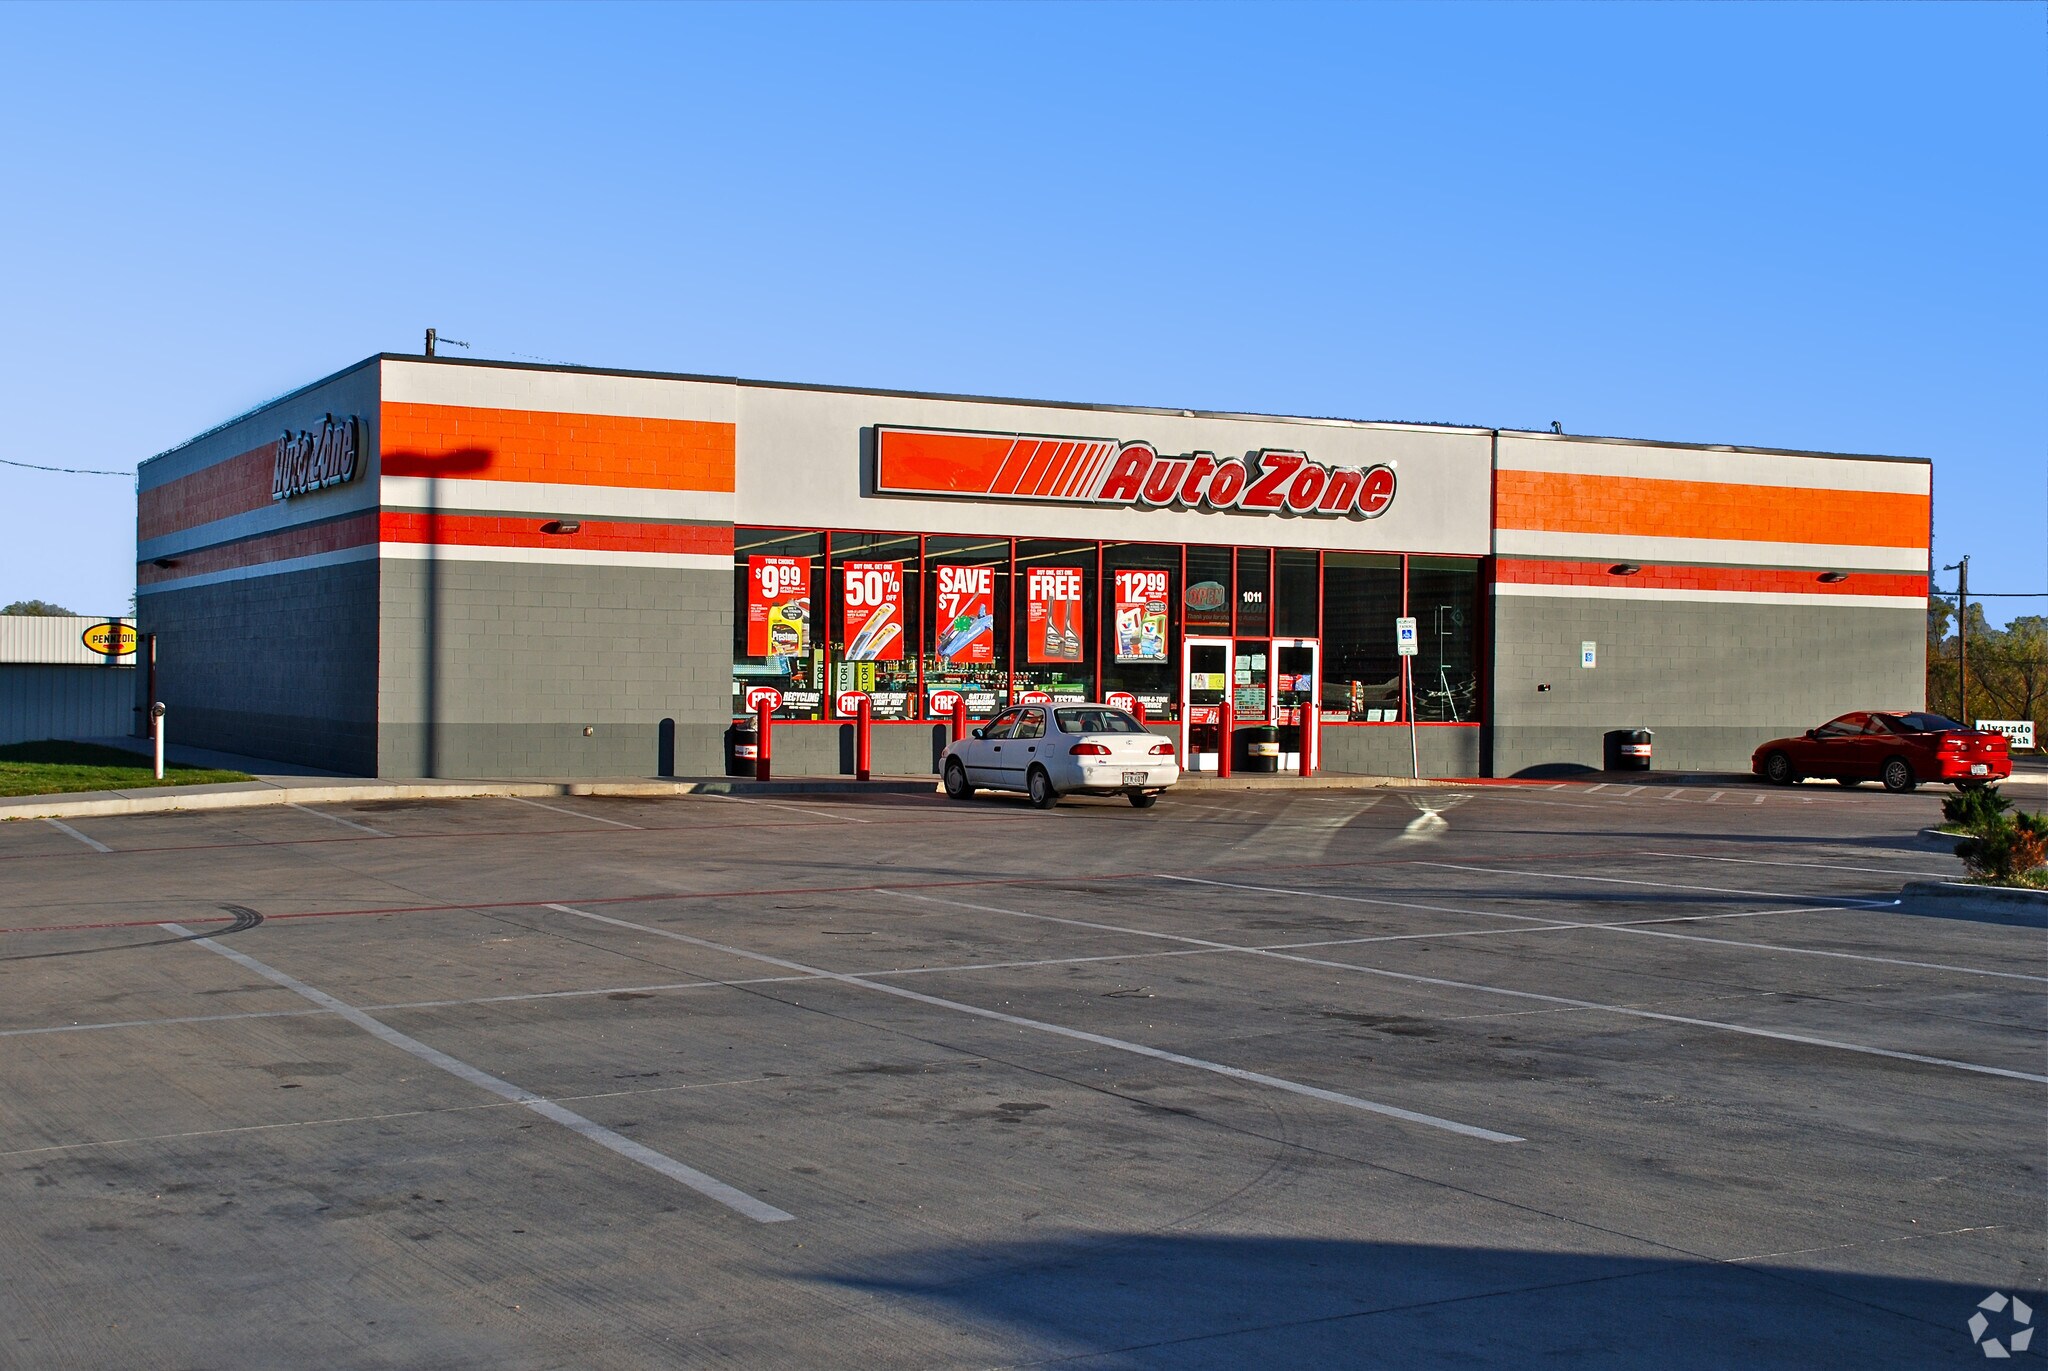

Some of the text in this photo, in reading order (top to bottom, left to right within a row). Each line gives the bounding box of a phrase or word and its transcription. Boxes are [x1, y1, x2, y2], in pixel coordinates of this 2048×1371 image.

[272, 413, 361, 500] AutoZone
[1098, 446, 1395, 519] AutoZone
[845, 570, 900, 606] 50%
[939, 567, 991, 594] SAVE
[1029, 575, 1080, 601] FREE
[1188, 586, 1223, 606] OPEN
[1243, 591, 1262, 603] 1011
[938, 592, 960, 618] $7
[92, 633, 135, 644] PENNZOIL
[772, 630, 798, 643] Prestone
[783, 691, 820, 702] RECYCLING
[1054, 695, 1085, 703] TESTING
[1109, 696, 1133, 711] FREE
[1980, 723, 2031, 733] Alvarado
[2011, 736, 2029, 744] ash
